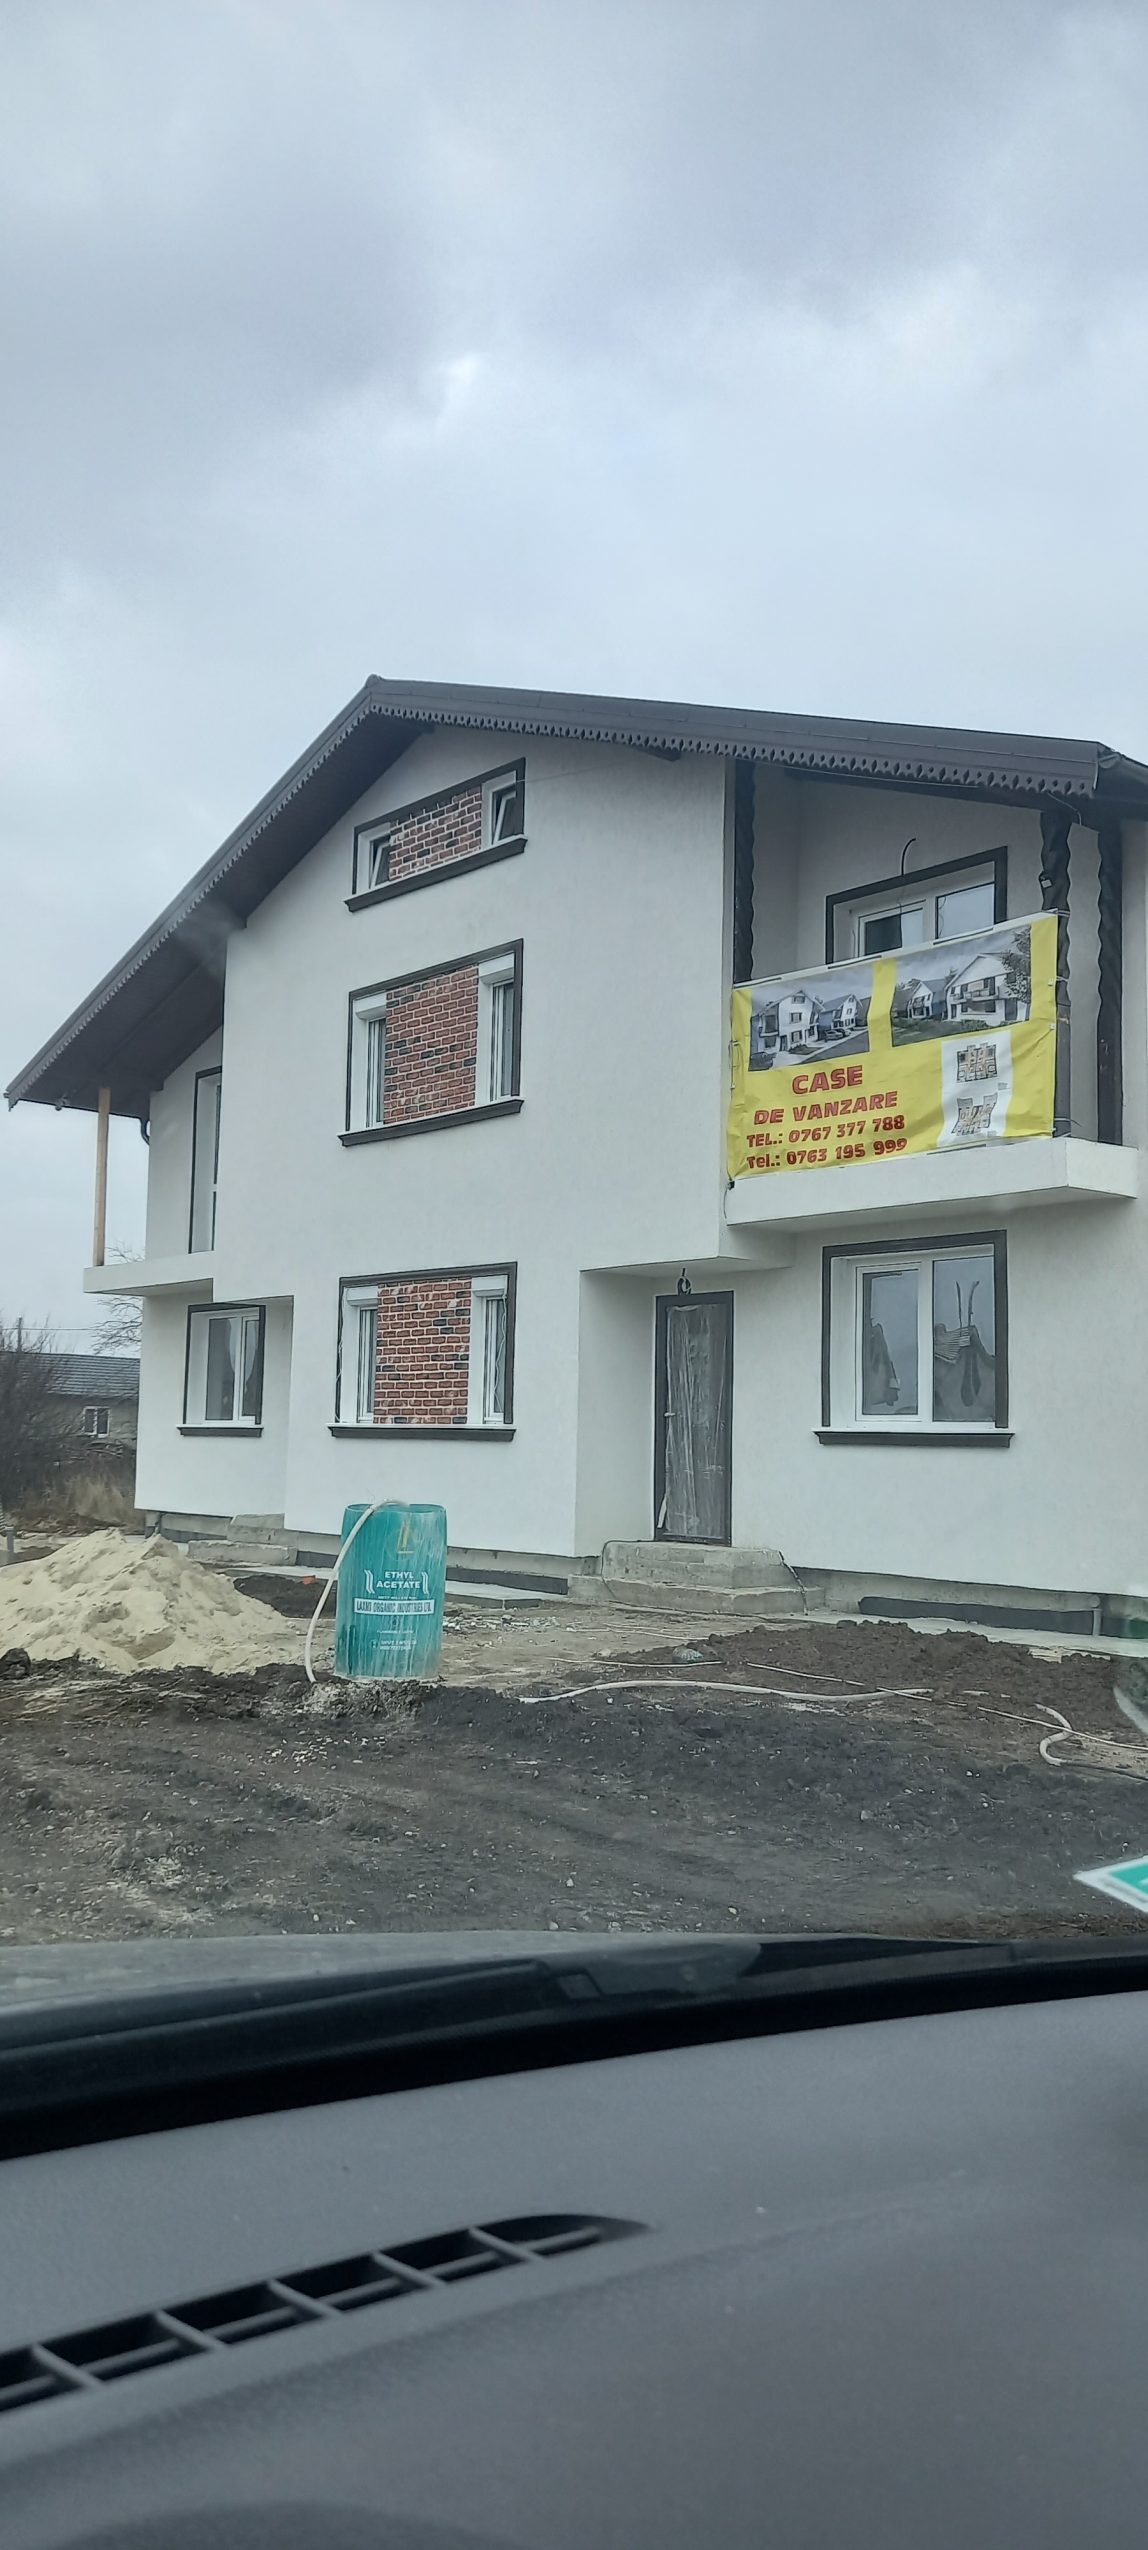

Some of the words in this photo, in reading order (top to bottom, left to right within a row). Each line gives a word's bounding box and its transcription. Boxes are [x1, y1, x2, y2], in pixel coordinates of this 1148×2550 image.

[792, 1065, 863, 1094] CASE
[754, 1109, 784, 1125] DE
[792, 1091, 898, 1121] VANZARE
[746, 1133, 783, 1148] TEL.:
[788, 1126, 831, 1143] 0767
[837, 1120, 866, 1138] 377
[872, 1114, 905, 1132] 788
[746, 1153, 781, 1168] Tel.:
[786, 1148, 828, 1165] 0763
[835, 1143, 866, 1160] 195
[873, 1137, 908, 1155] 999
[376, 1581, 421, 1589] ACETATE
[384, 1571, 414, 1579] ETHYL
